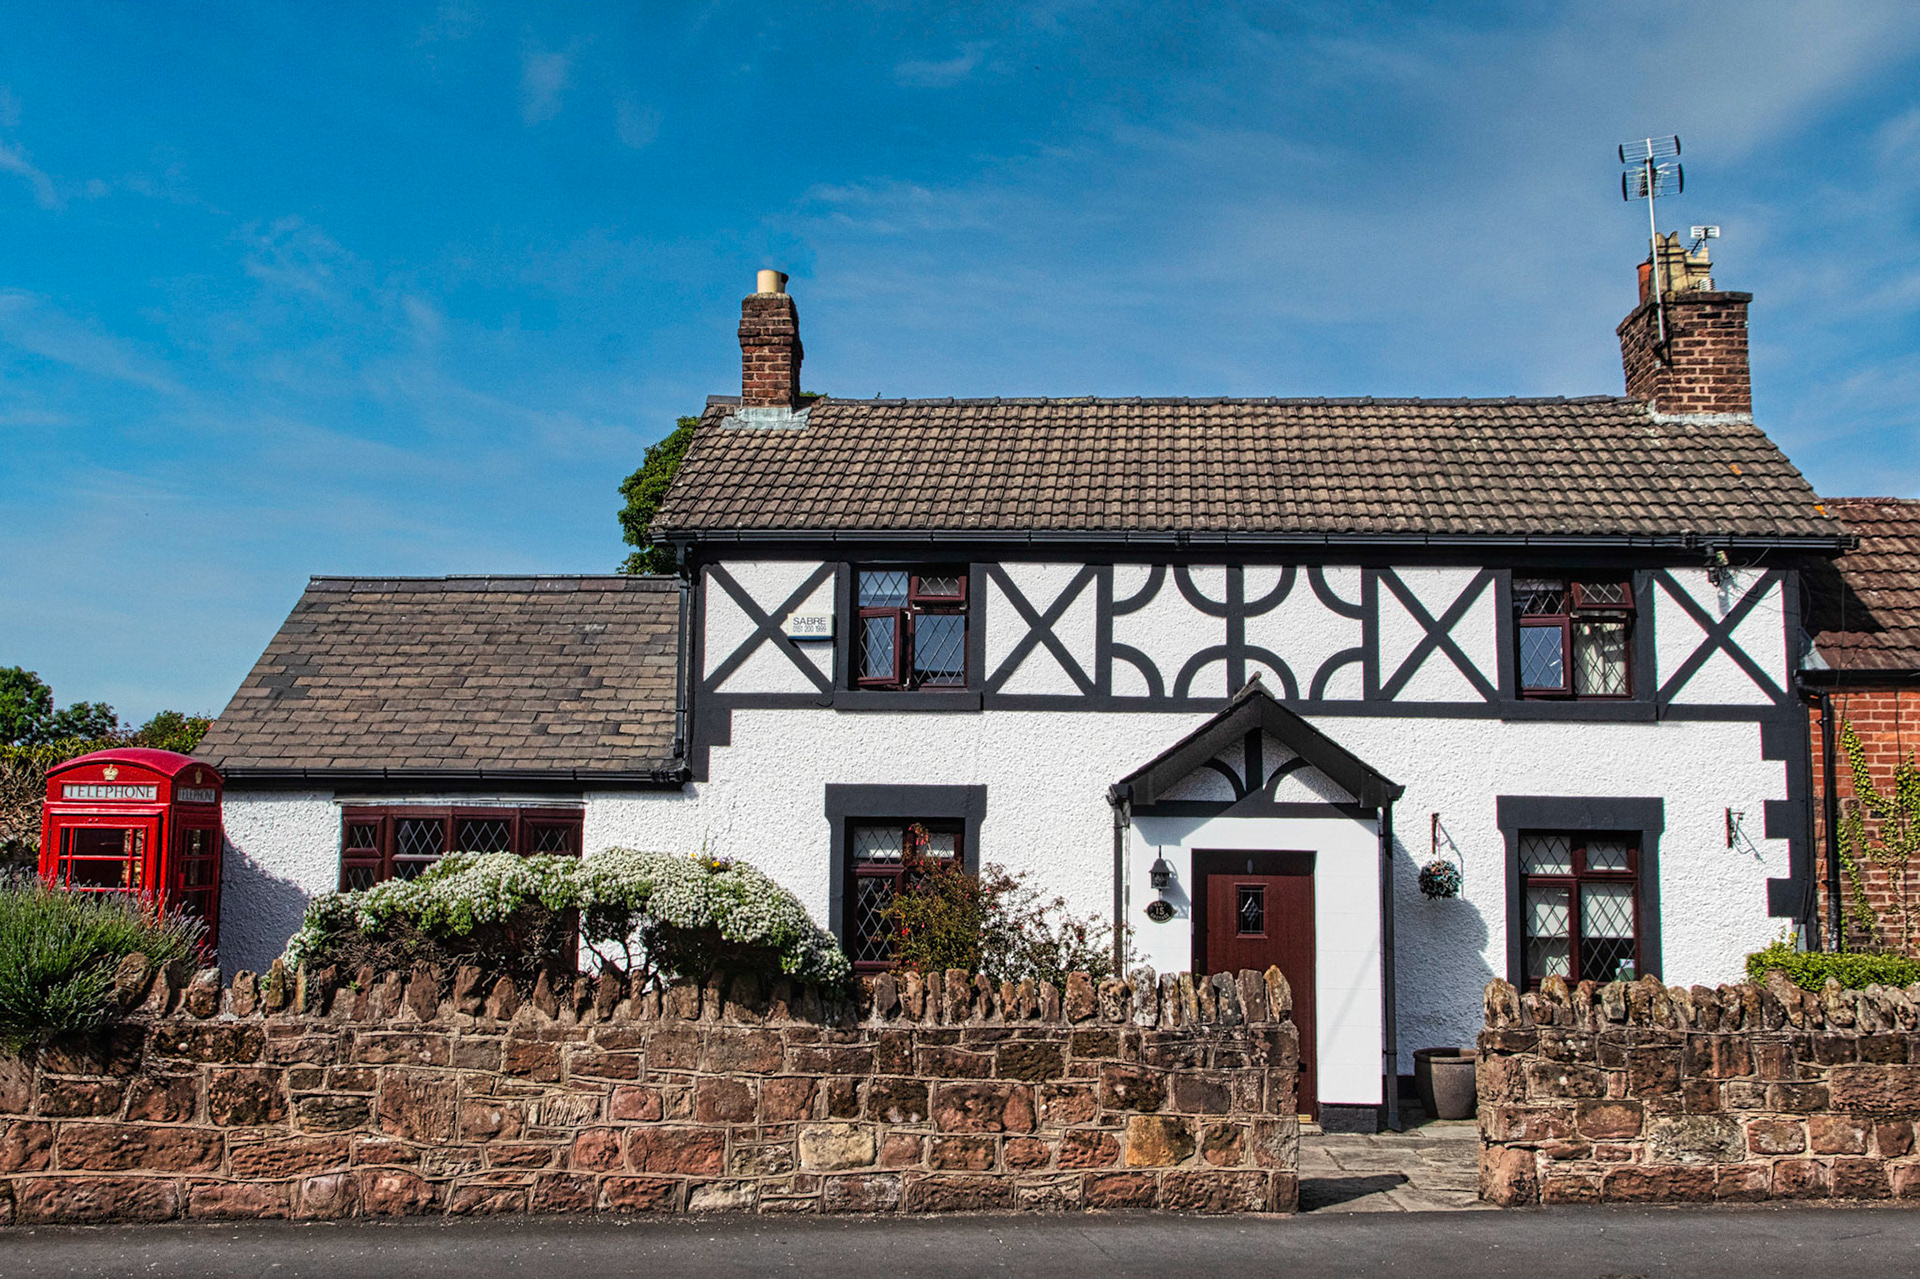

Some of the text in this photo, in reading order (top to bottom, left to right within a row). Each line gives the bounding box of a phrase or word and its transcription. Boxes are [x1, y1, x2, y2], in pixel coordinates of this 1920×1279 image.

[793, 617, 827, 625] SABRE
[804, 625, 814, 633] 200
[66, 784, 154, 798] TELEPHONE
[178, 788, 213, 800] TELEPHONE
[1155, 907, 1165, 915] 15
